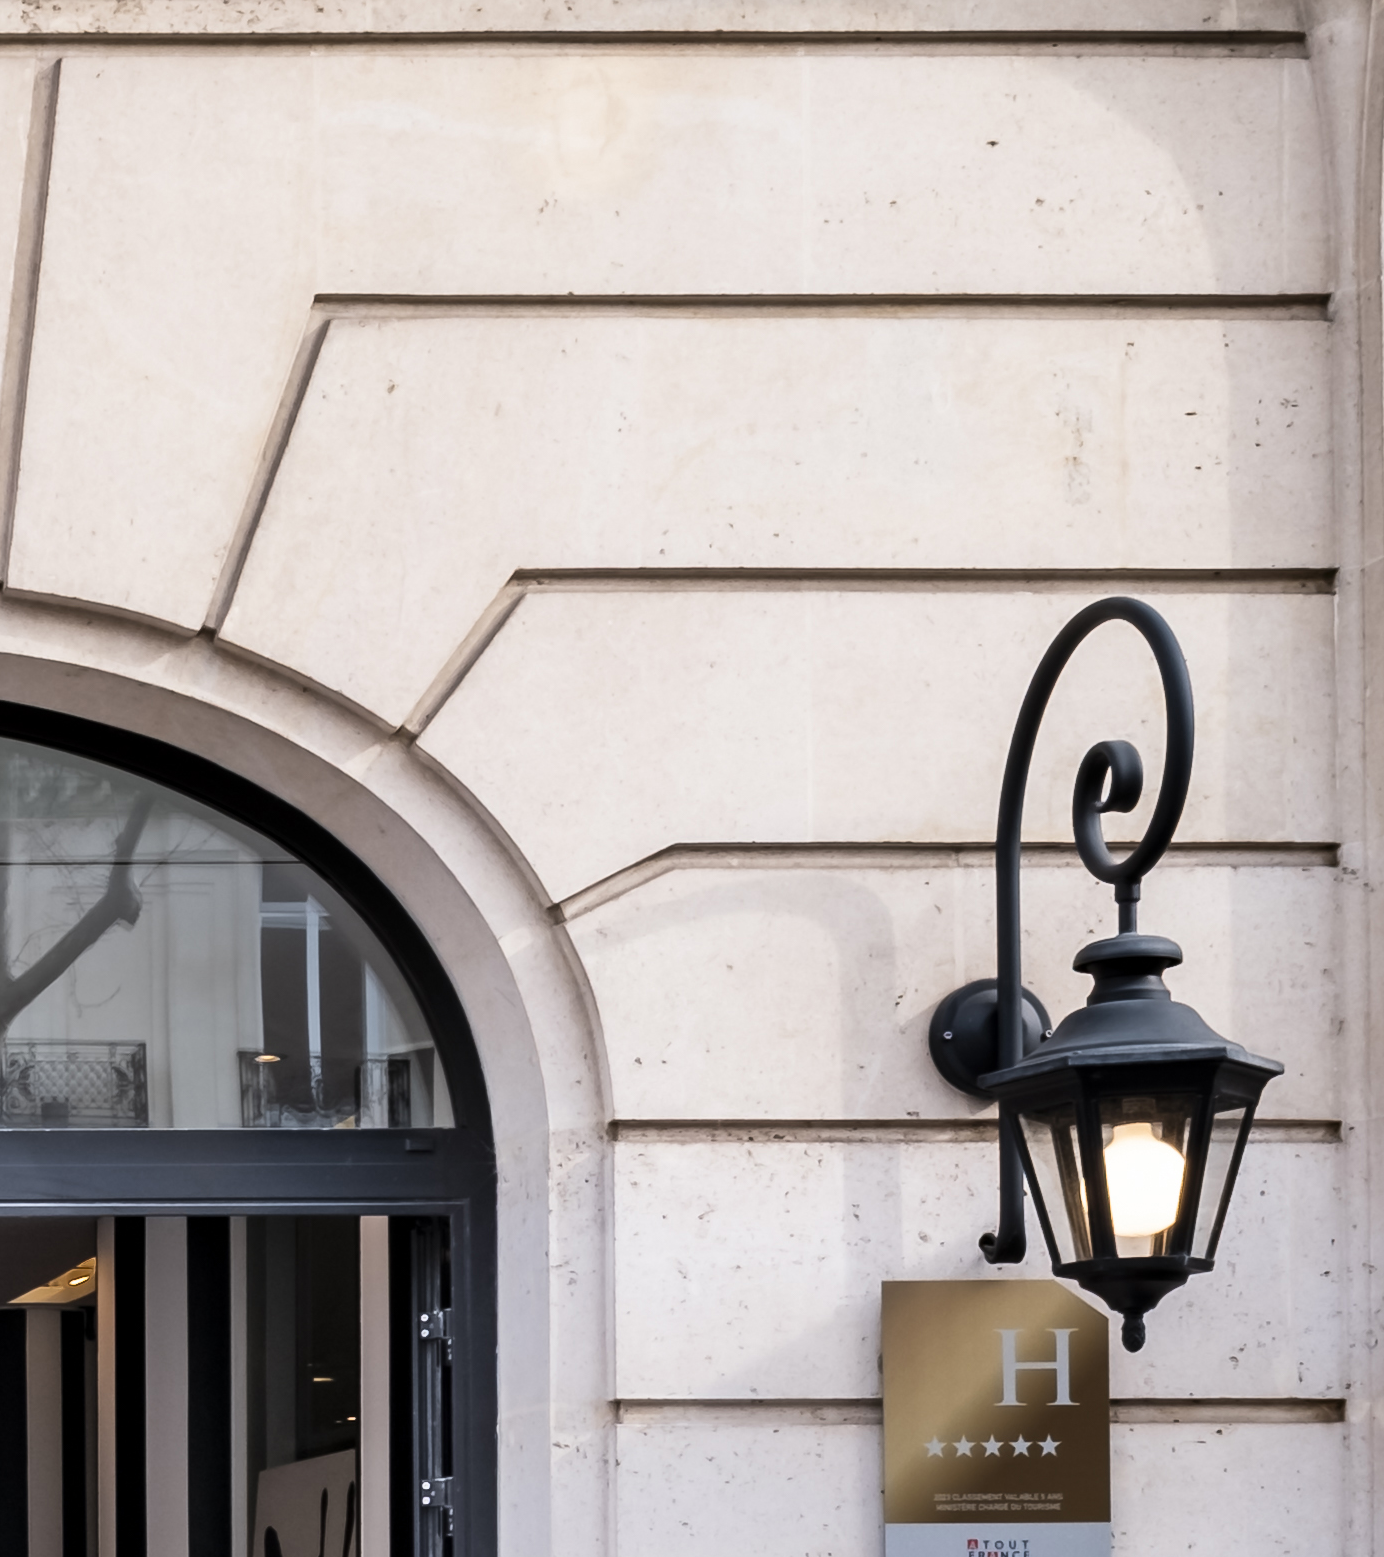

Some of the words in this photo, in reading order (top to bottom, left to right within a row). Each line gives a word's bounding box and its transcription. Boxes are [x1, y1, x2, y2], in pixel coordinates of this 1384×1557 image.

[993, 1327, 1081, 1407] H
[952, 1492, 1003, 1501] CLASSEMENT
[1004, 1493, 1039, 1501] VALABLE
[1046, 1493, 1063, 1501] ANS
[1010, 1503, 1021, 1511] DU
[1023, 1503, 1061, 1511] TOURISME
